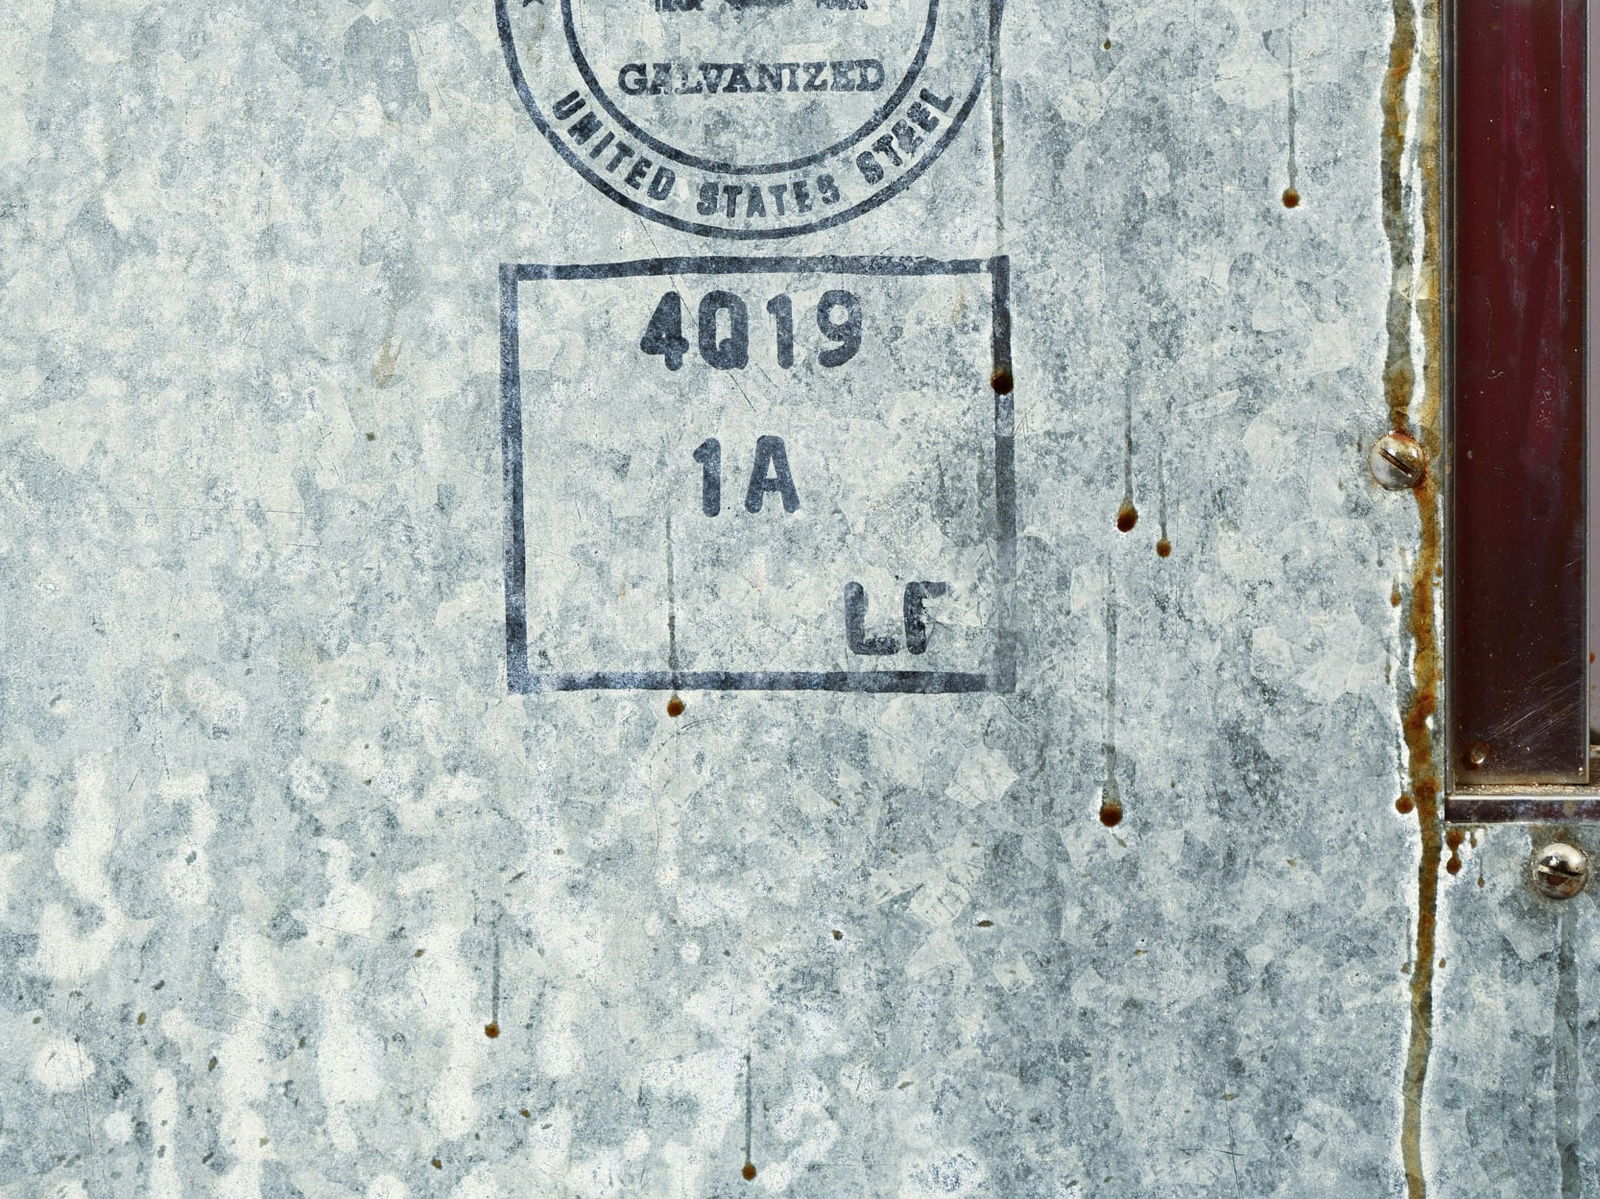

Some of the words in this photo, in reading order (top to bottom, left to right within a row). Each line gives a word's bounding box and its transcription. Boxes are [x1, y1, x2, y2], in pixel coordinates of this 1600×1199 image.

[618, 58, 886, 96] GALVANIZED
[551, 90, 676, 201] UNITED
[696, 173, 841, 218] STATES
[855, 88, 954, 186] STEEL
[639, 289, 863, 371] 4Q19
[692, 435, 801, 518] 1A
